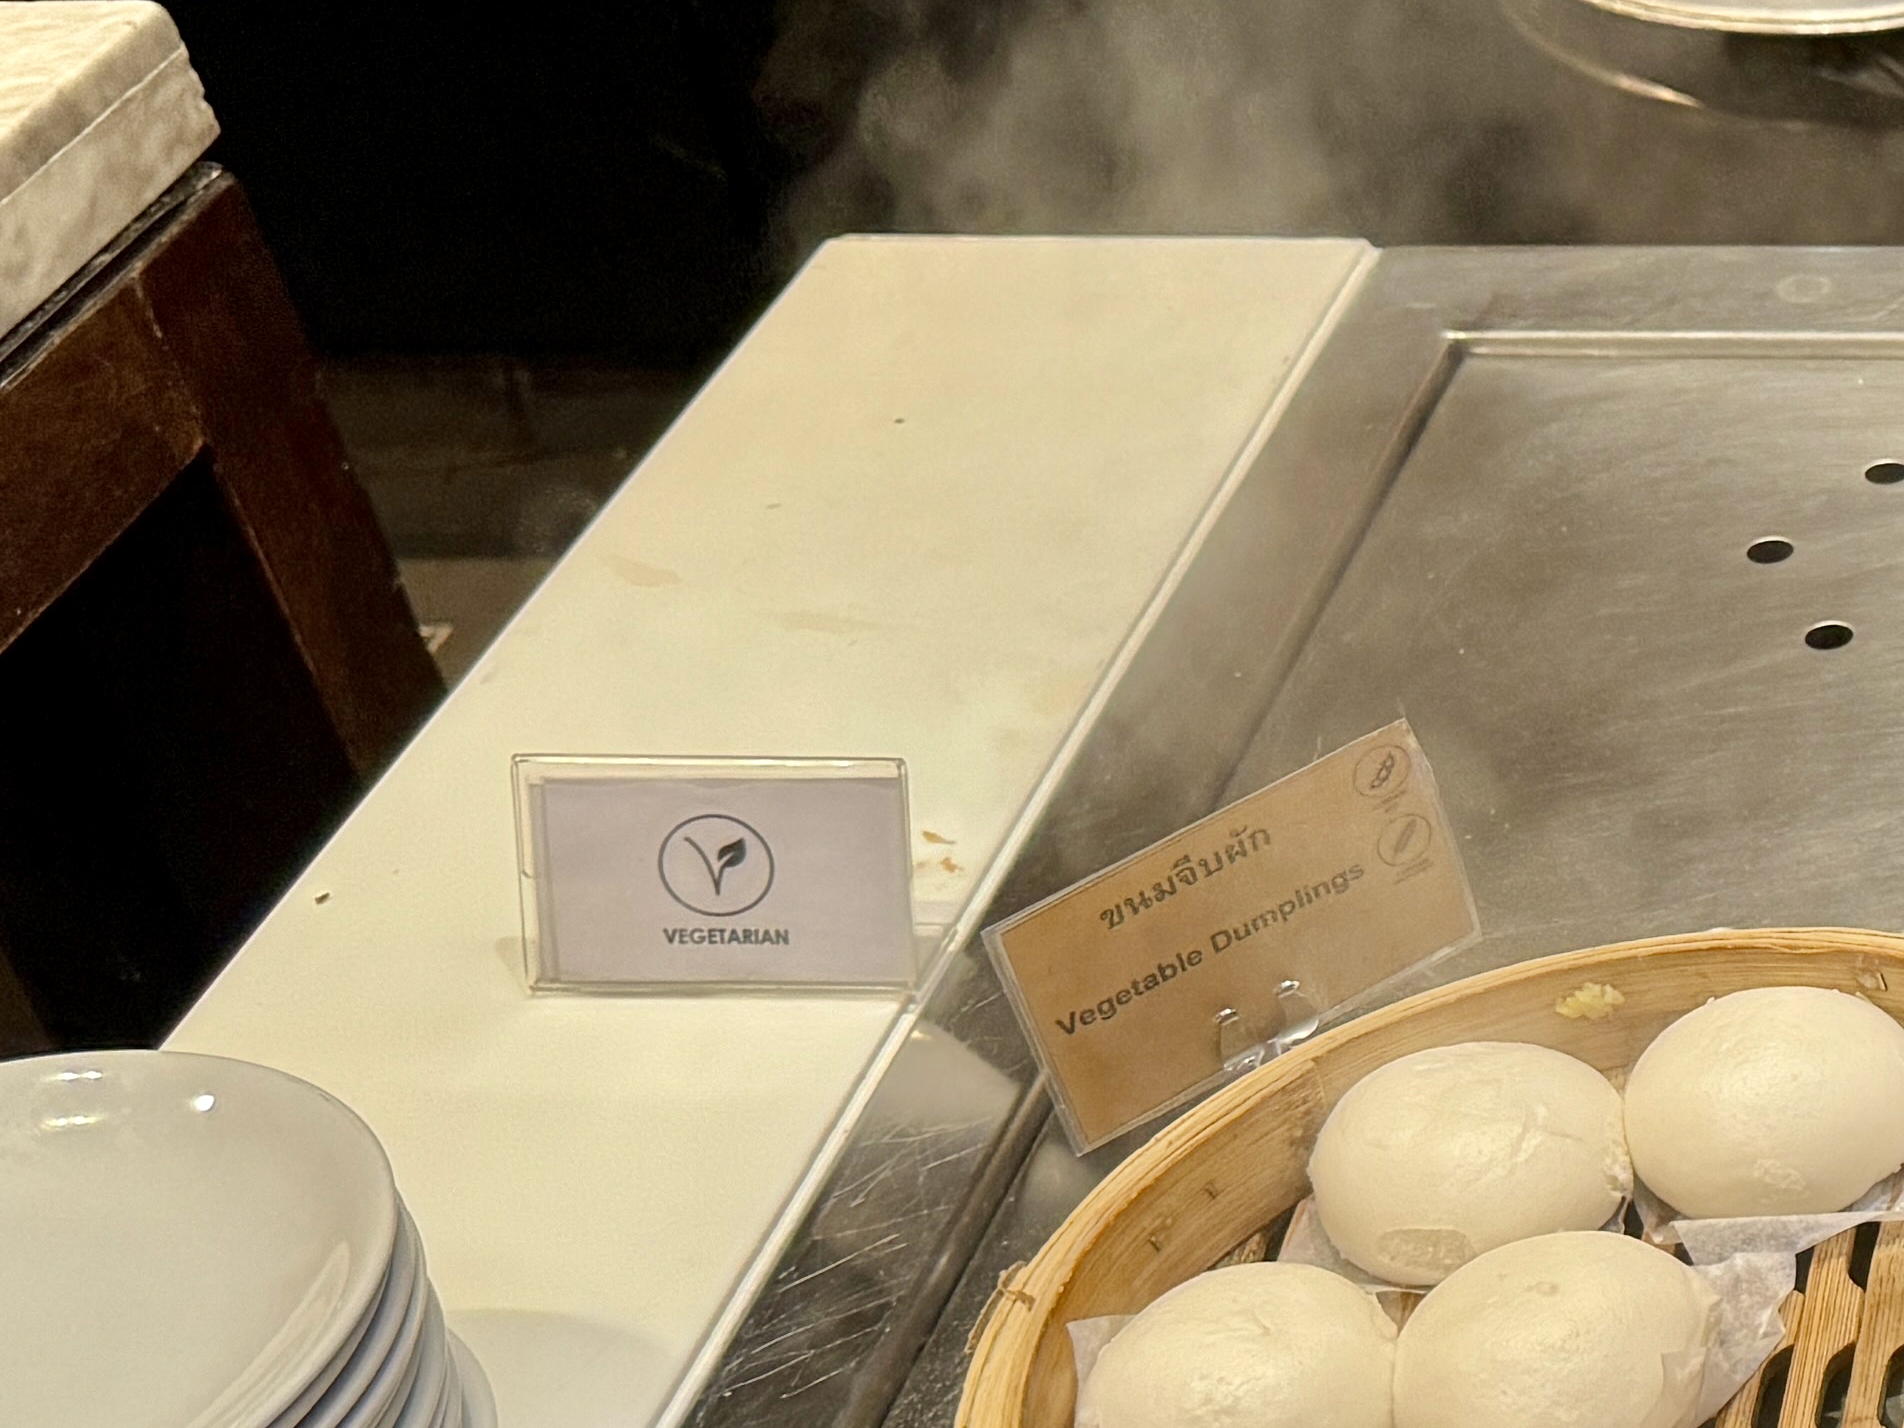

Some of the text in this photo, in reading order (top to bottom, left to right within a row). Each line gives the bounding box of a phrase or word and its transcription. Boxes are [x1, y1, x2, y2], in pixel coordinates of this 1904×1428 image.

[1099, 825, 1272, 930] ขนมจีบผัก
[662, 927, 790, 945] VEGETARIAN
[1055, 863, 1366, 1036] Vegetable Dumplings
